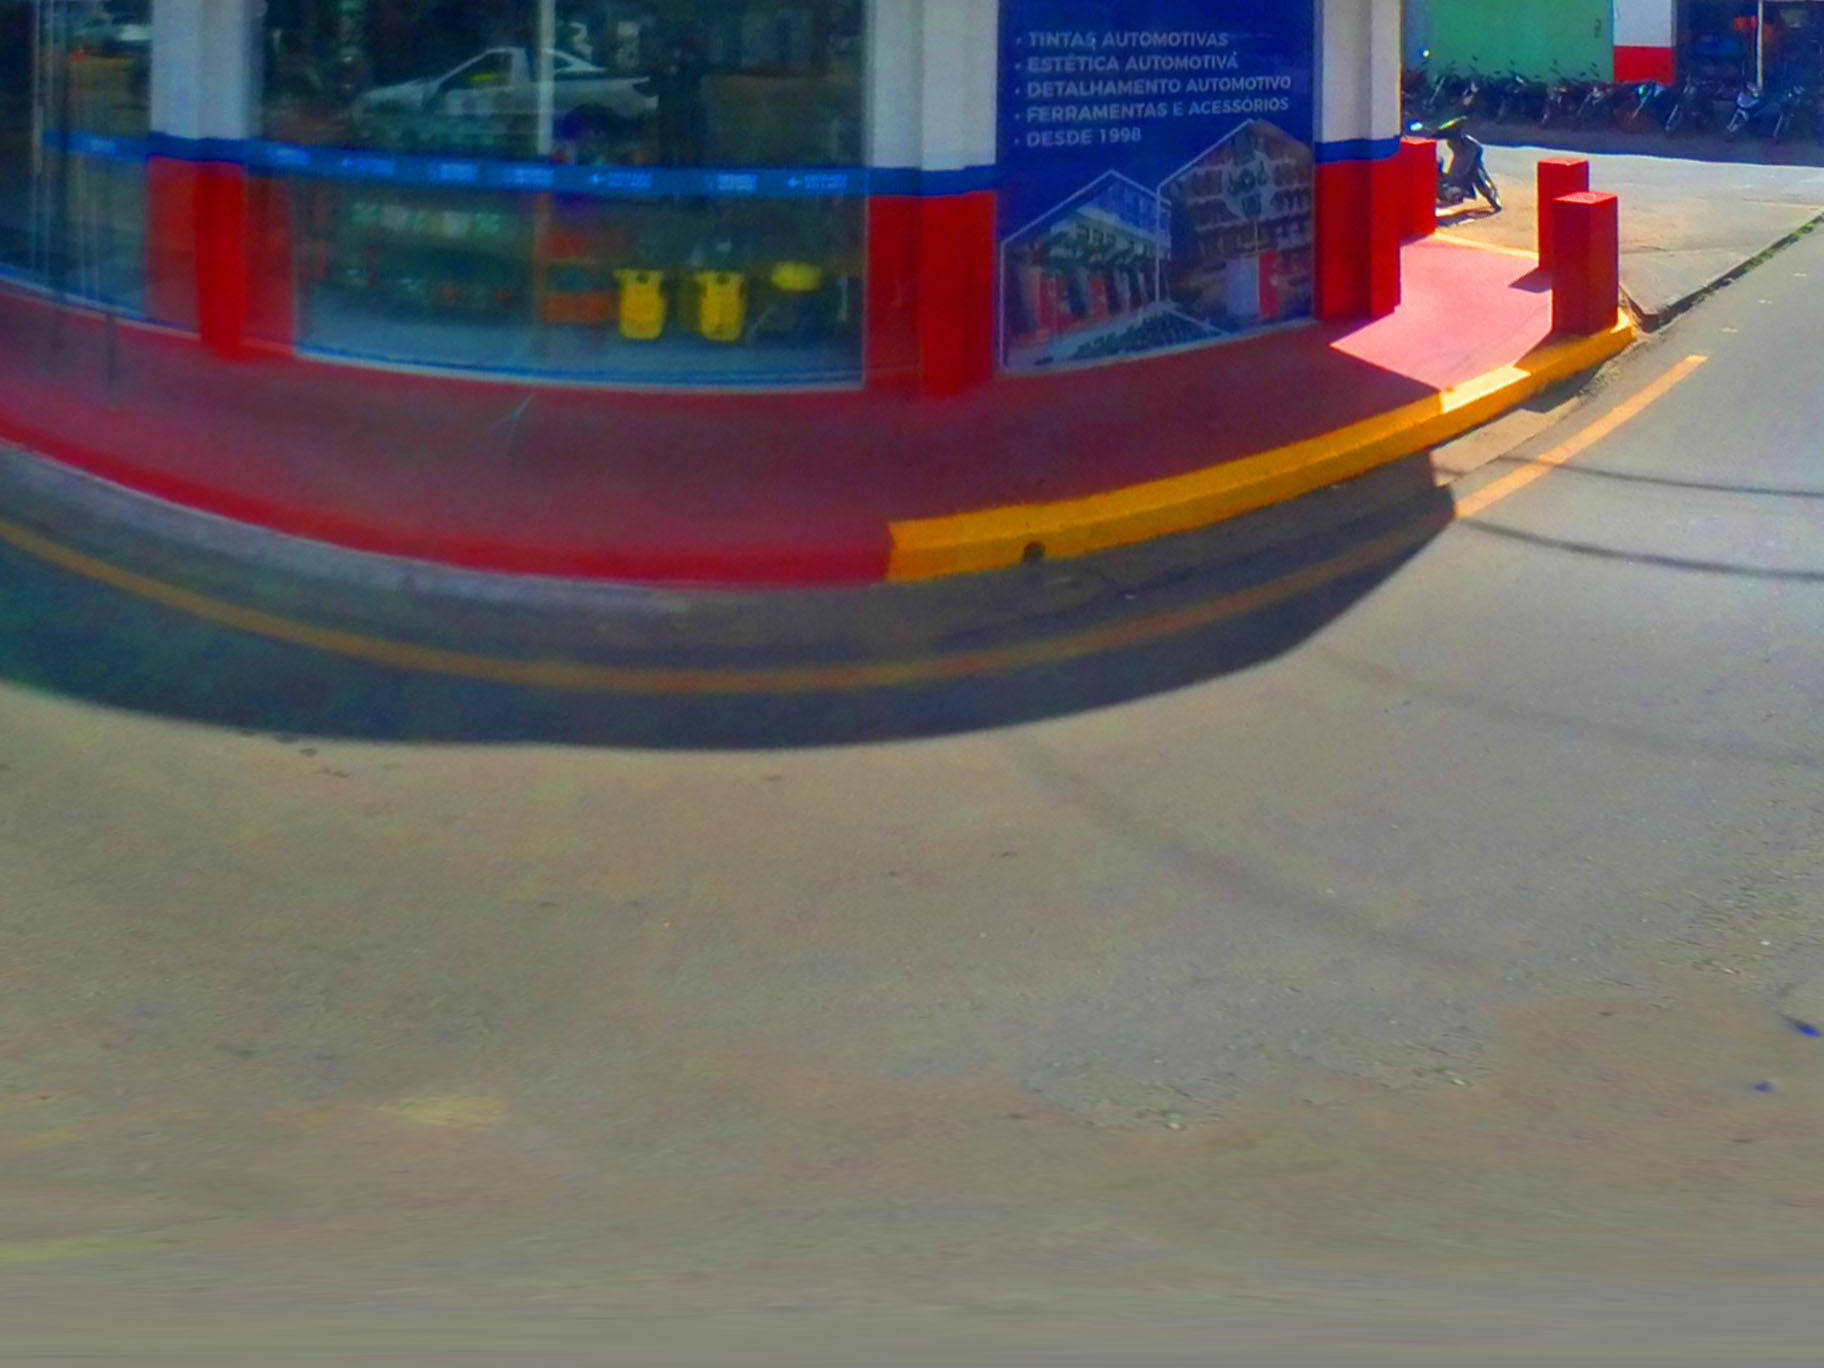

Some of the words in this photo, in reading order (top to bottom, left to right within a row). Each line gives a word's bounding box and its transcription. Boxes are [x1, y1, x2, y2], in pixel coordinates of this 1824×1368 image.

[1027, 31, 1095, 49] TINTAS
[1102, 31, 1230, 48] AUTOMOTIVAS
[1027, 53, 1120, 73] ESTÉTICA
[1027, 78, 1181, 99] DETALHAMENTO
[1186, 75, 1292, 94] AUTOMOTIVO
[1027, 102, 1169, 123] FERRAMENTAS
[1172, 103, 1184, 118] E
[1188, 94, 1290, 116] ACESSÓRIOS
[1027, 129, 1093, 148] DESDE
[1099, 126, 1143, 145] 1998
